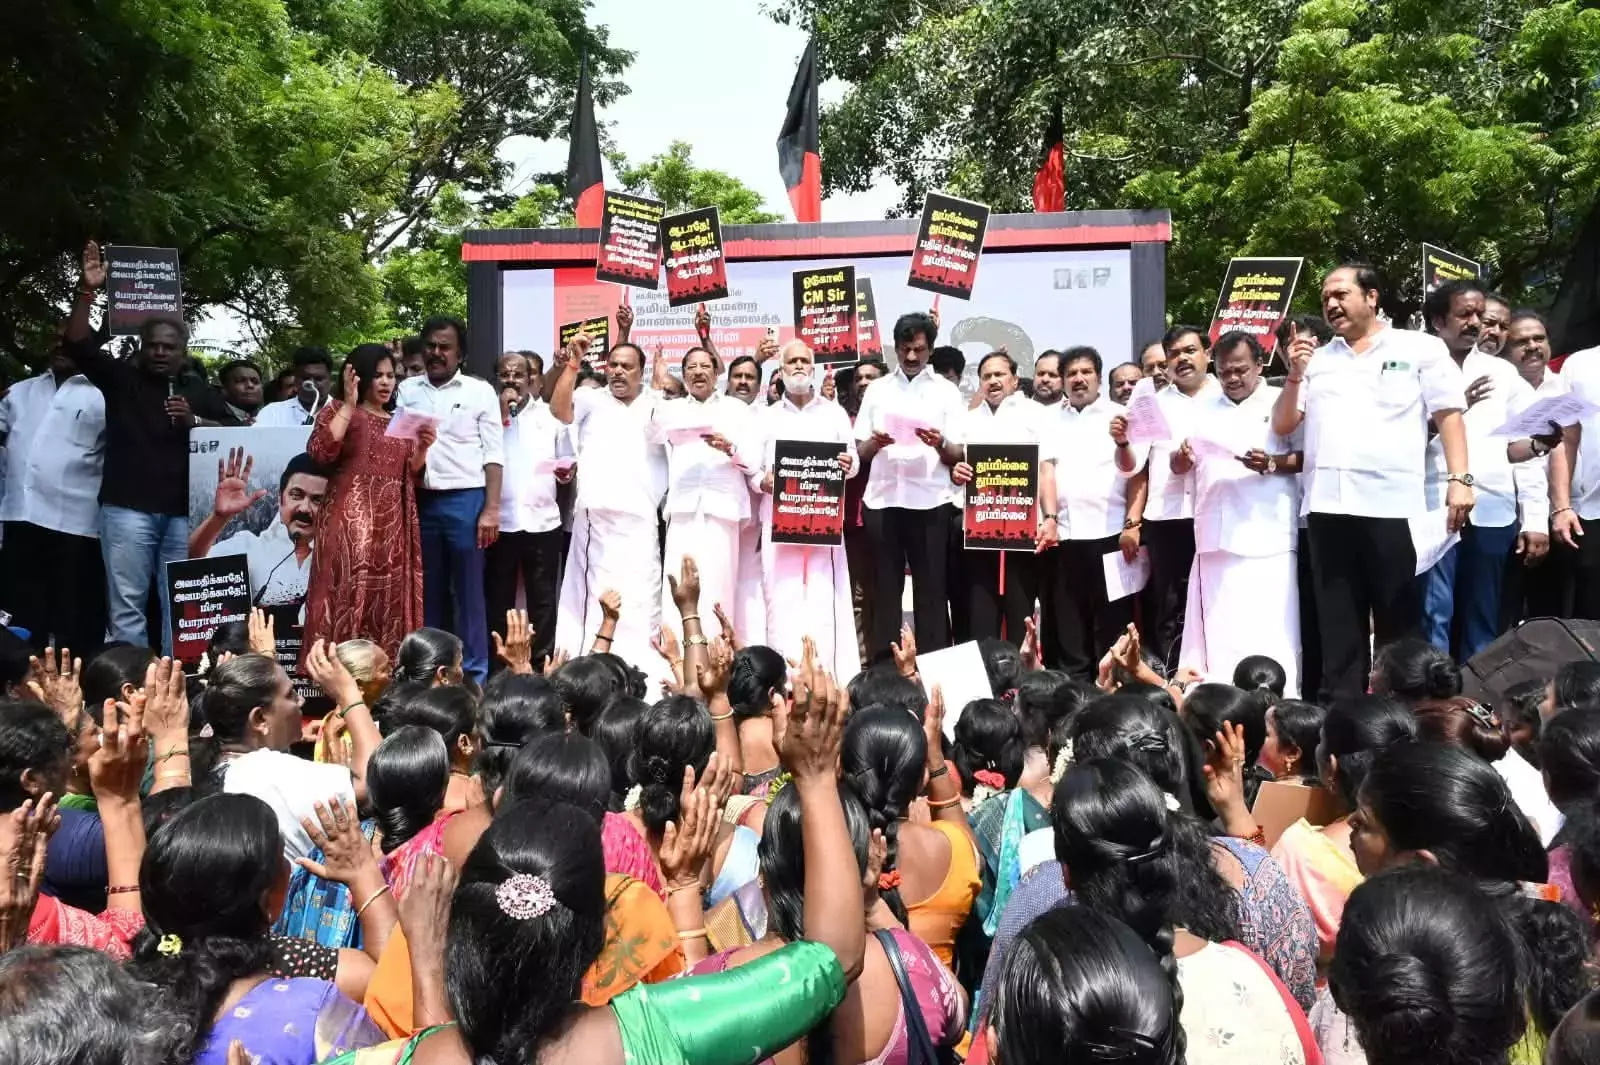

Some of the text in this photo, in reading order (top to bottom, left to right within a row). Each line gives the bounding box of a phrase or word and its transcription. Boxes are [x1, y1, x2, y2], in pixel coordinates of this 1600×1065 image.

[931, 208, 978, 229] துப்பில்லை
[668, 218, 710, 237] ஆடாதே!
[928, 222, 975, 242] துப்பில்லை
[920, 239, 976, 260] பதில் சொல்ல
[111, 260, 174, 271] அவமதிக்காதே!
[922, 253, 968, 272] துப்பில்லை
[111, 270, 176, 281] அவமதிக்காதே!!
[677, 263, 713, 279] ஆடாதே
[134, 281, 155, 289] மிசா
[1233, 272, 1286, 288] துப்பில்லை
[803, 288, 846, 304] CM Sir
[1228, 287, 1281, 303] துப்பில்லை
[115, 301, 178, 312] அவமதிக்காதே!
[1219, 305, 1280, 320] பதில் சொல்ல
[814, 335, 830, 345] sir
[975, 457, 1029, 473] துப்பில்லை
[779, 468, 842, 480] அவமதிக்காதே!!
[975, 472, 1028, 488] துப்பில்லை
[800, 481, 820, 490] மிசா
[970, 491, 1033, 505] பதில் சொல்ல
[778, 504, 839, 517] அவமதிக்காதே!
[975, 507, 1027, 522] துப்பில்லை
[174, 570, 244, 589] அவமதிக்காதே!
[174, 584, 247, 602] அவமதிக்காதே!!
[200, 601, 223, 612] மிசா
[178, 614, 247, 629] போராளிகளை
